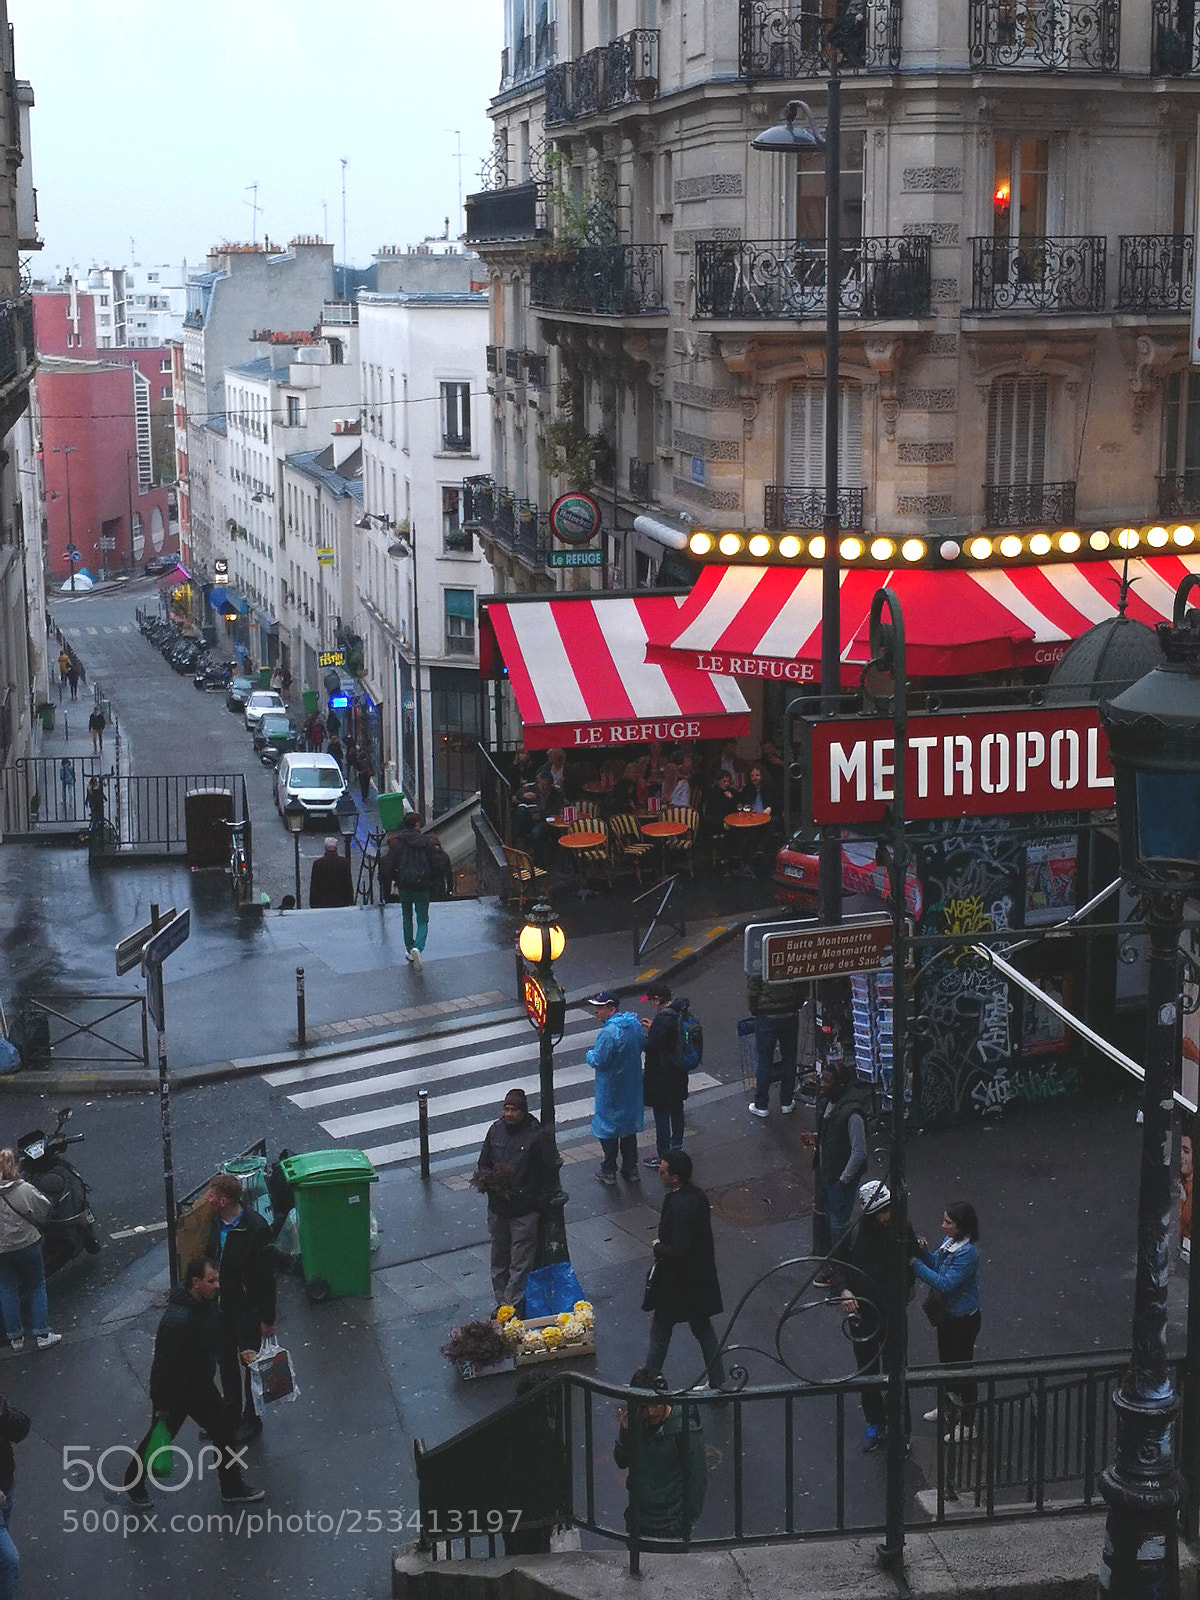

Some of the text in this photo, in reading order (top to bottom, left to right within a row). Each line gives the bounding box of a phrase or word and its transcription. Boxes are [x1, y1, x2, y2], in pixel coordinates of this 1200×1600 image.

[552, 553, 600, 565] Le REFUGE
[1034, 647, 1066, 662] Café
[697, 655, 814, 680] LE REFUGE
[574, 721, 701, 745] LE REFUGE
[829, 727, 1115, 803] METROPOL
[786, 933, 872, 950] Butte Montmartre
[786, 945, 877, 963] Musée Montmartre
[786, 965, 804, 974] Par
[806, 963, 815, 972] la
[819, 962, 834, 971] rue
[838, 959, 854, 968] des
